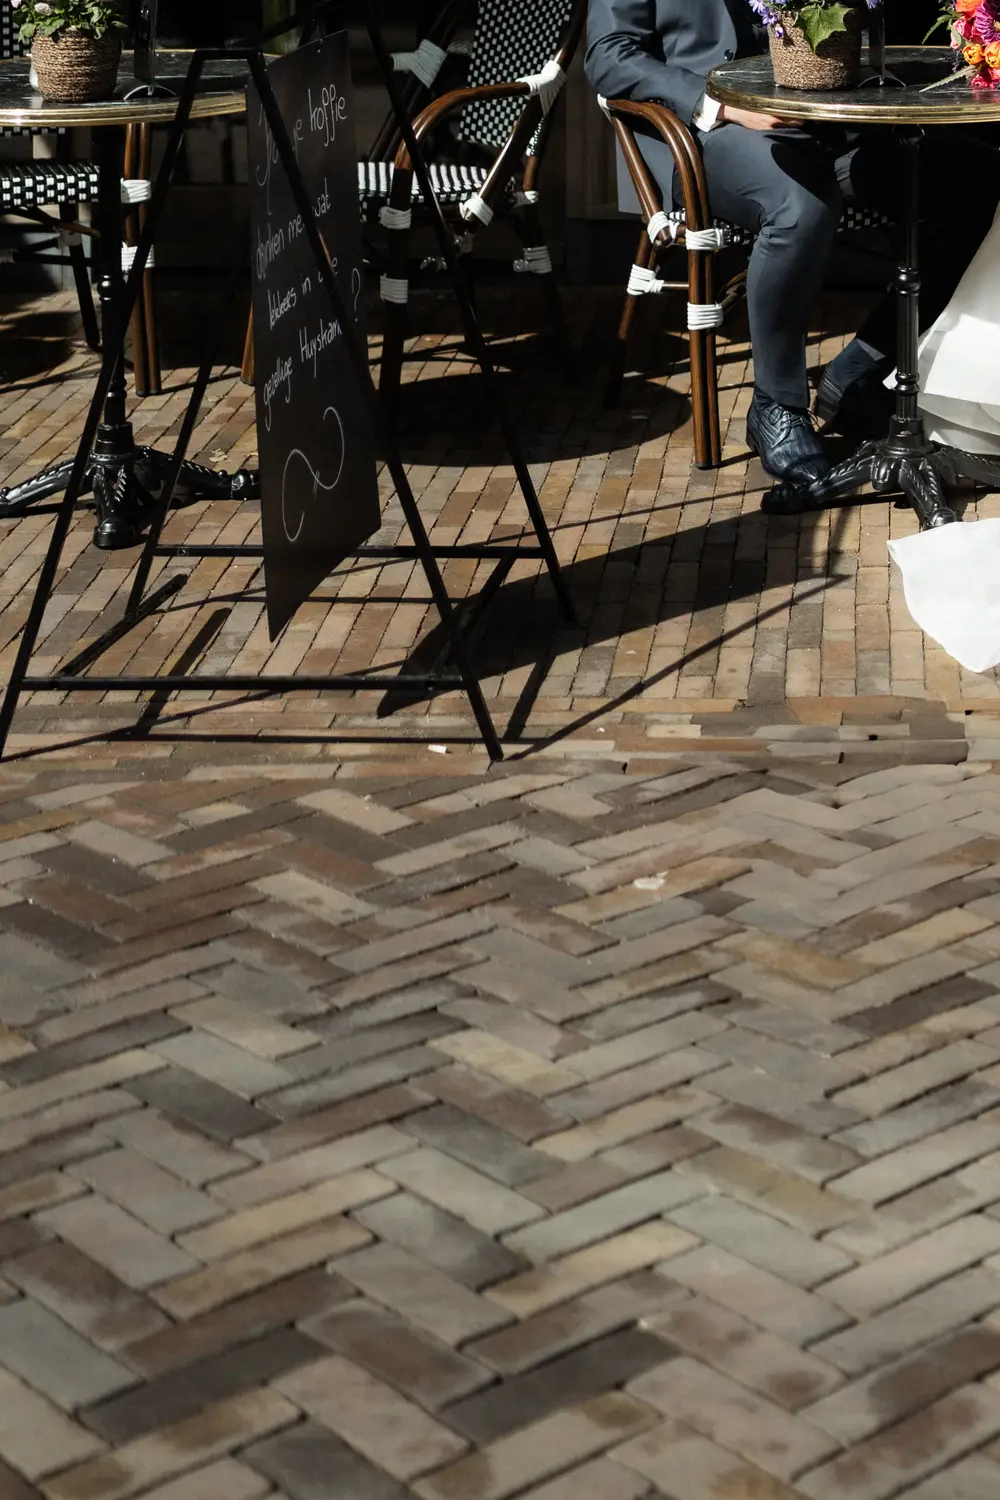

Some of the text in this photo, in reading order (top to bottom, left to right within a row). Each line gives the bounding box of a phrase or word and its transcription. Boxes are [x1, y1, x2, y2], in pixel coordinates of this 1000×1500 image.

[308, 84, 348, 147] koffie
[288, 213, 305, 243] me
[301, 273, 312, 296] in
